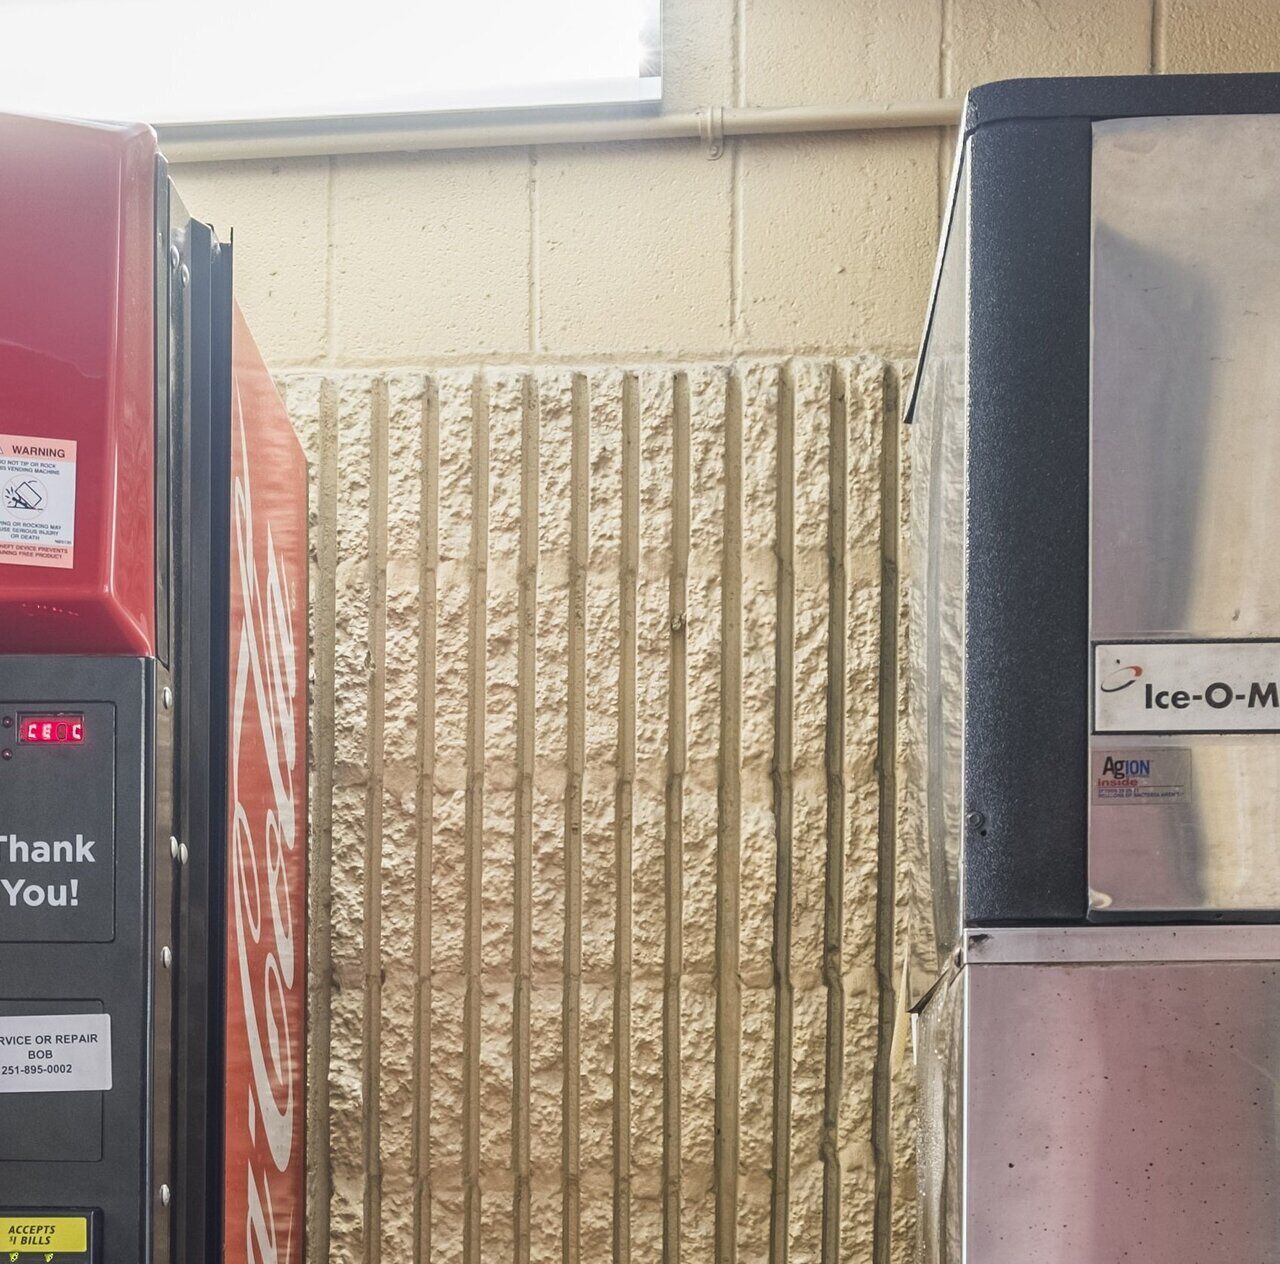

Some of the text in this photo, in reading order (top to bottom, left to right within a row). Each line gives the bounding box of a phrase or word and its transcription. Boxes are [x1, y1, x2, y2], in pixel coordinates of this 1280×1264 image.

[12, 445, 65, 458] WARNING
[7, 465, 33, 473] VENDING
[1097, 779, 1138, 787] inside
[0, 878, 79, 907] You!
[35, 1035, 52, 1045] OR
[55, 1034, 98, 1044] REPAIR
[28, 1050, 53, 1060] BOB
[1, 1064, 72, 1075] 251-895-0002
[8, 1225, 56, 1234] ACCEPTS
[20, 1236, 51, 1245] BILLS
